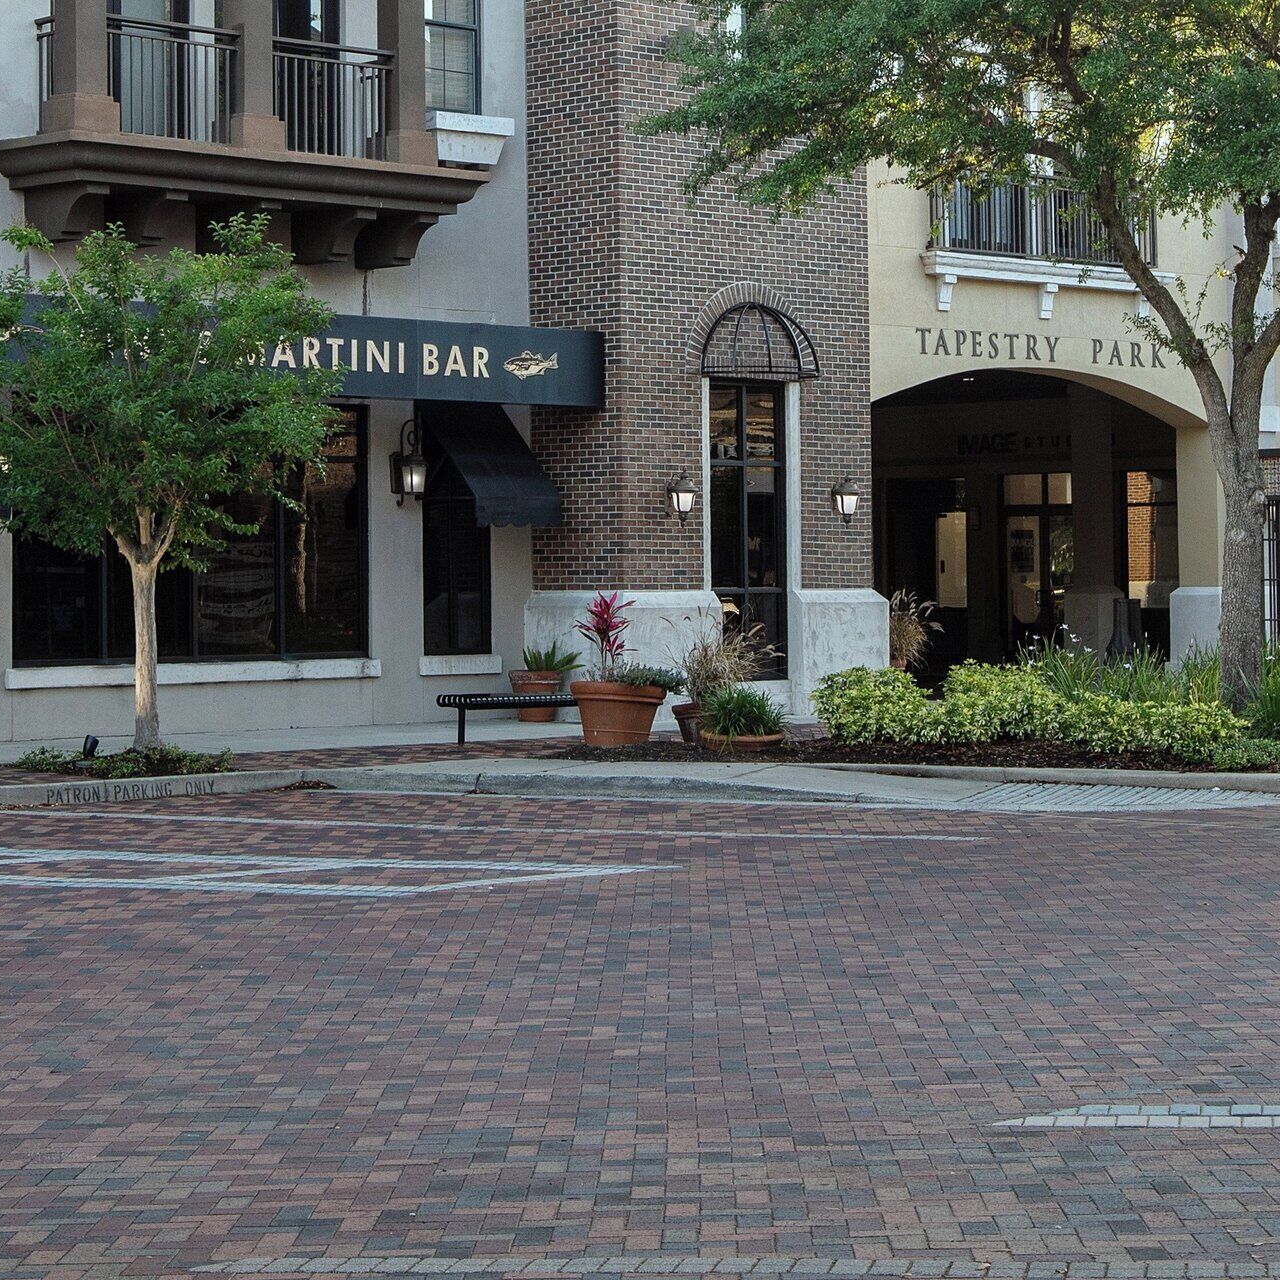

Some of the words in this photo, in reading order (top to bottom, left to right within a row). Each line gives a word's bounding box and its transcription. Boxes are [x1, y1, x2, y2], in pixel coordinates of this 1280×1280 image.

[422, 342, 490, 379] BAR
[915, 327, 1060, 363] TAPESTRY
[1091, 337, 1167, 369] PARK
[957, 431, 1018, 455] IMAGE
